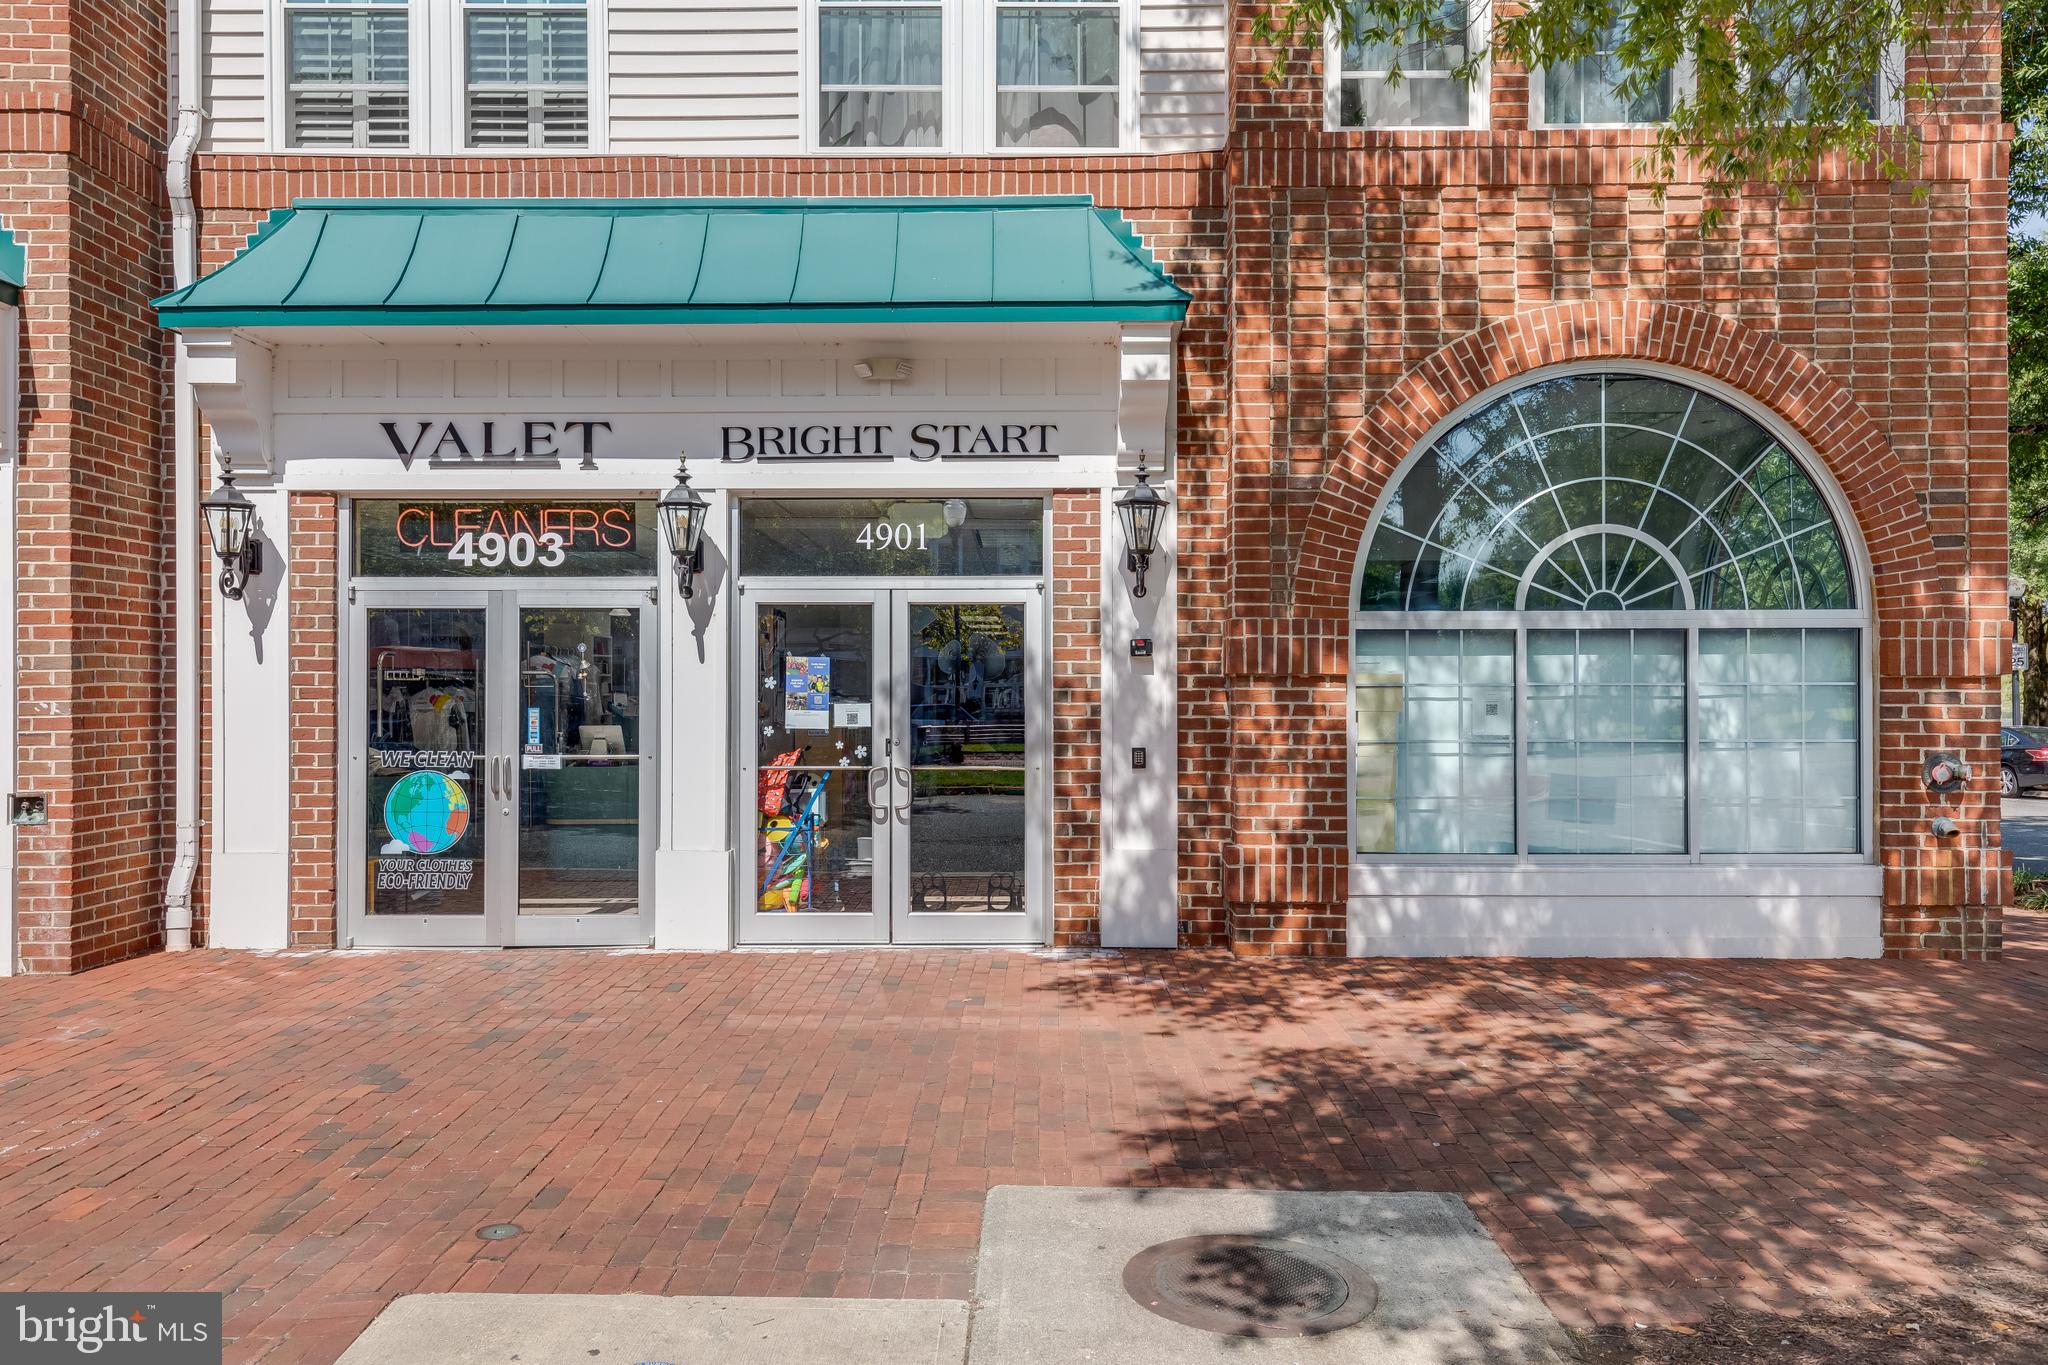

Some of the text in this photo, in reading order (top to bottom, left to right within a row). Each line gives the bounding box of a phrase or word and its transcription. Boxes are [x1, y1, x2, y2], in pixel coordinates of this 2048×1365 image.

[379, 421, 613, 472] VALET
[720, 423, 1058, 464] BRIGHT START
[396, 508, 632, 547] CLEANERS
[855, 522, 928, 551] 4901
[448, 532, 566, 567] 4903
[380, 750, 475, 768] WE CLEAN
[377, 873, 474, 890] ECO-FRIENDLY
[378, 859, 474, 872] YOUR CLOTHES
